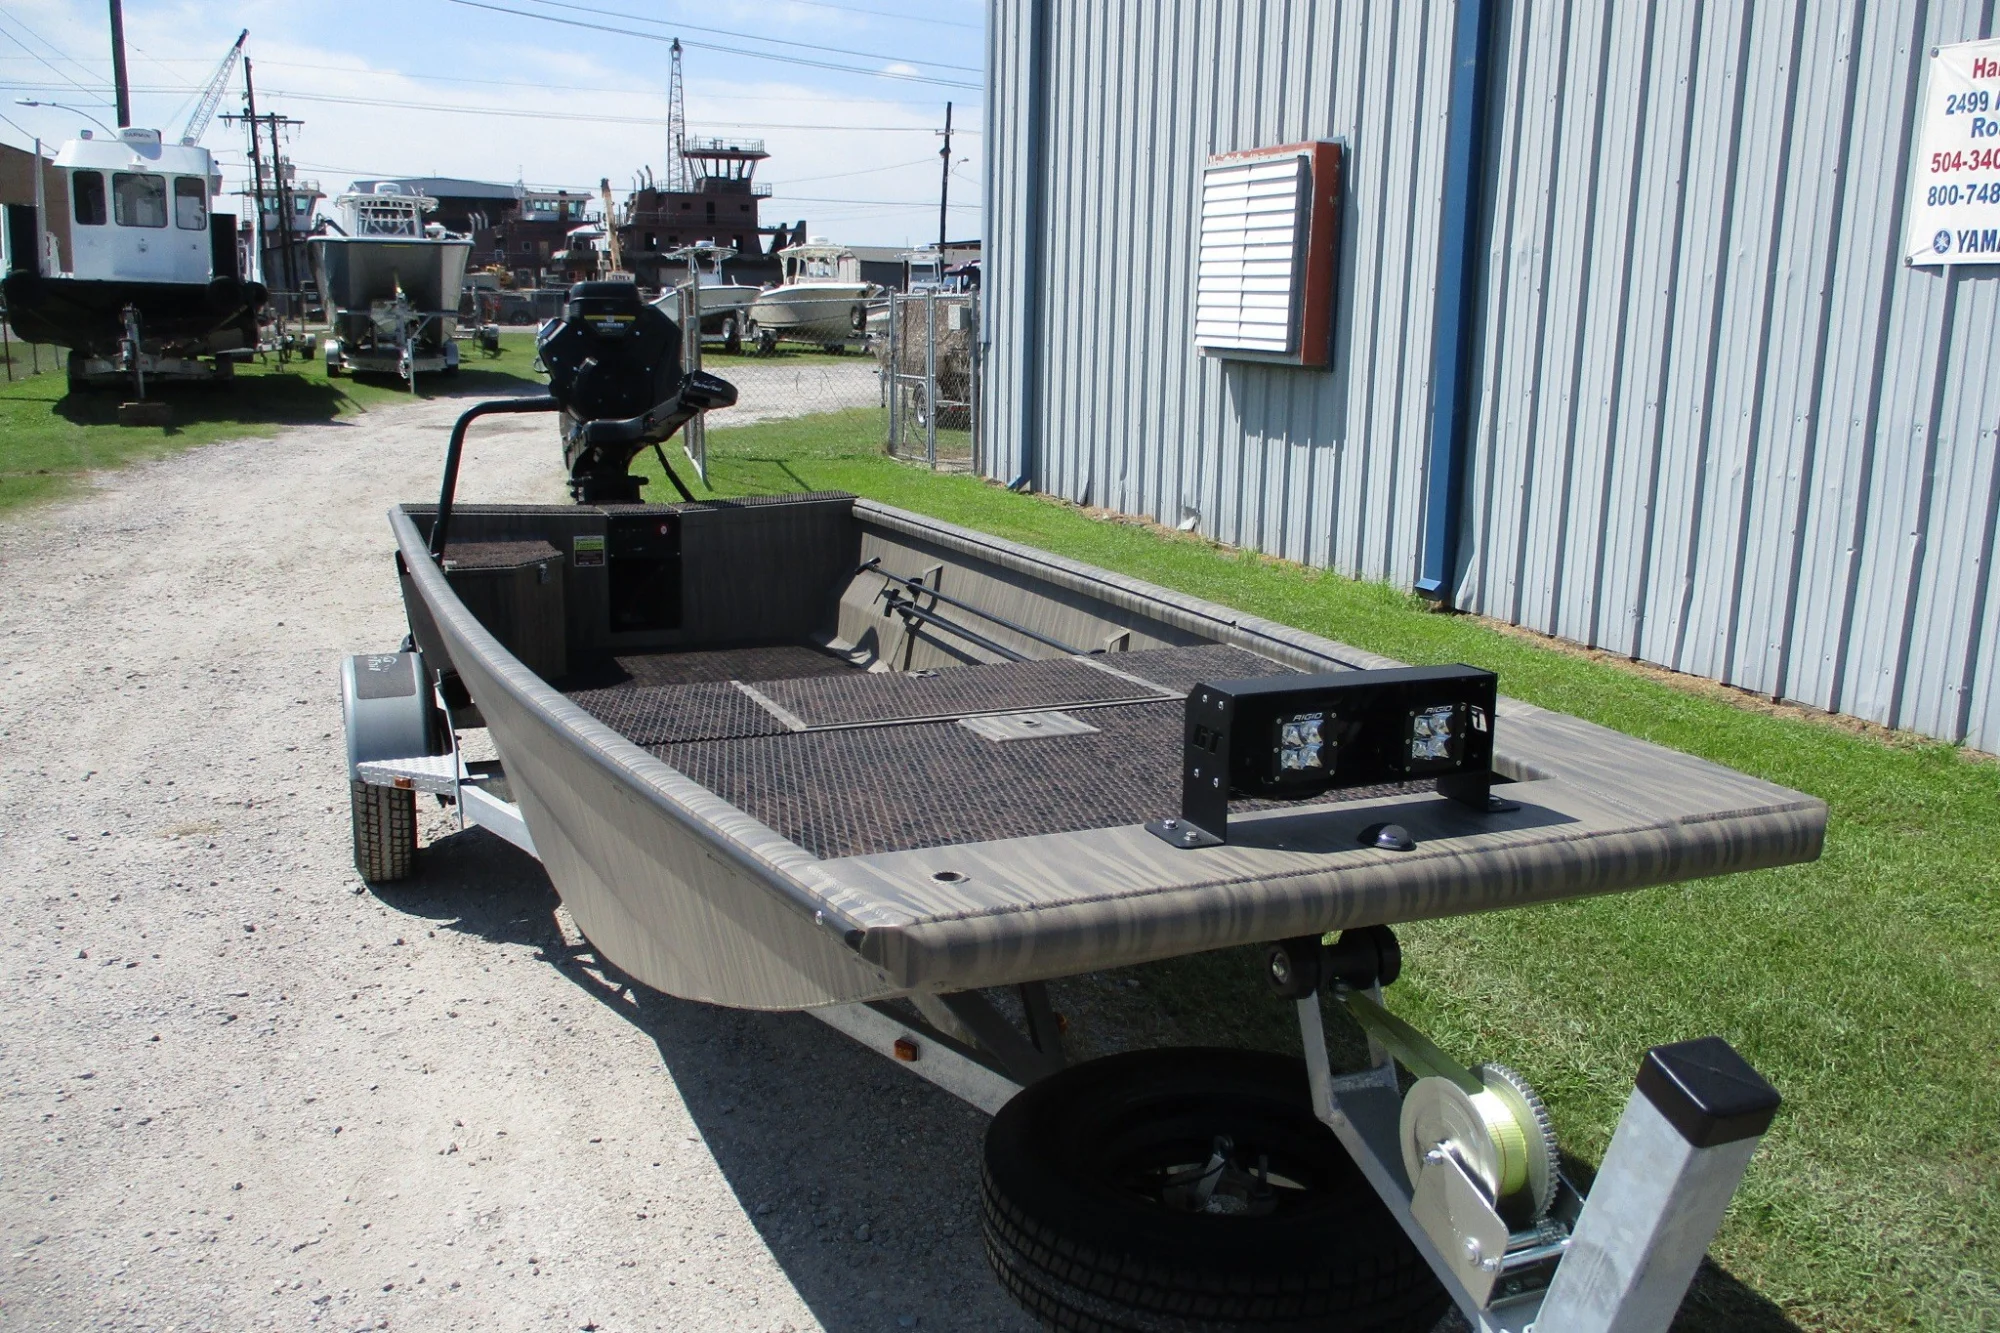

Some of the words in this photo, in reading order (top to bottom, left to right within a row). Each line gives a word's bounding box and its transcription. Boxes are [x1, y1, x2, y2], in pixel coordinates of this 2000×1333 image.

[1972, 57, 2000, 79] Ha
[1945, 90, 1989, 116] 2499
[1970, 117, 2000, 138] Ro
[1927, 182, 2000, 207] 800-748
[1292, 712, 1323, 722] RIGID
[1424, 704, 1453, 714] RIGID
